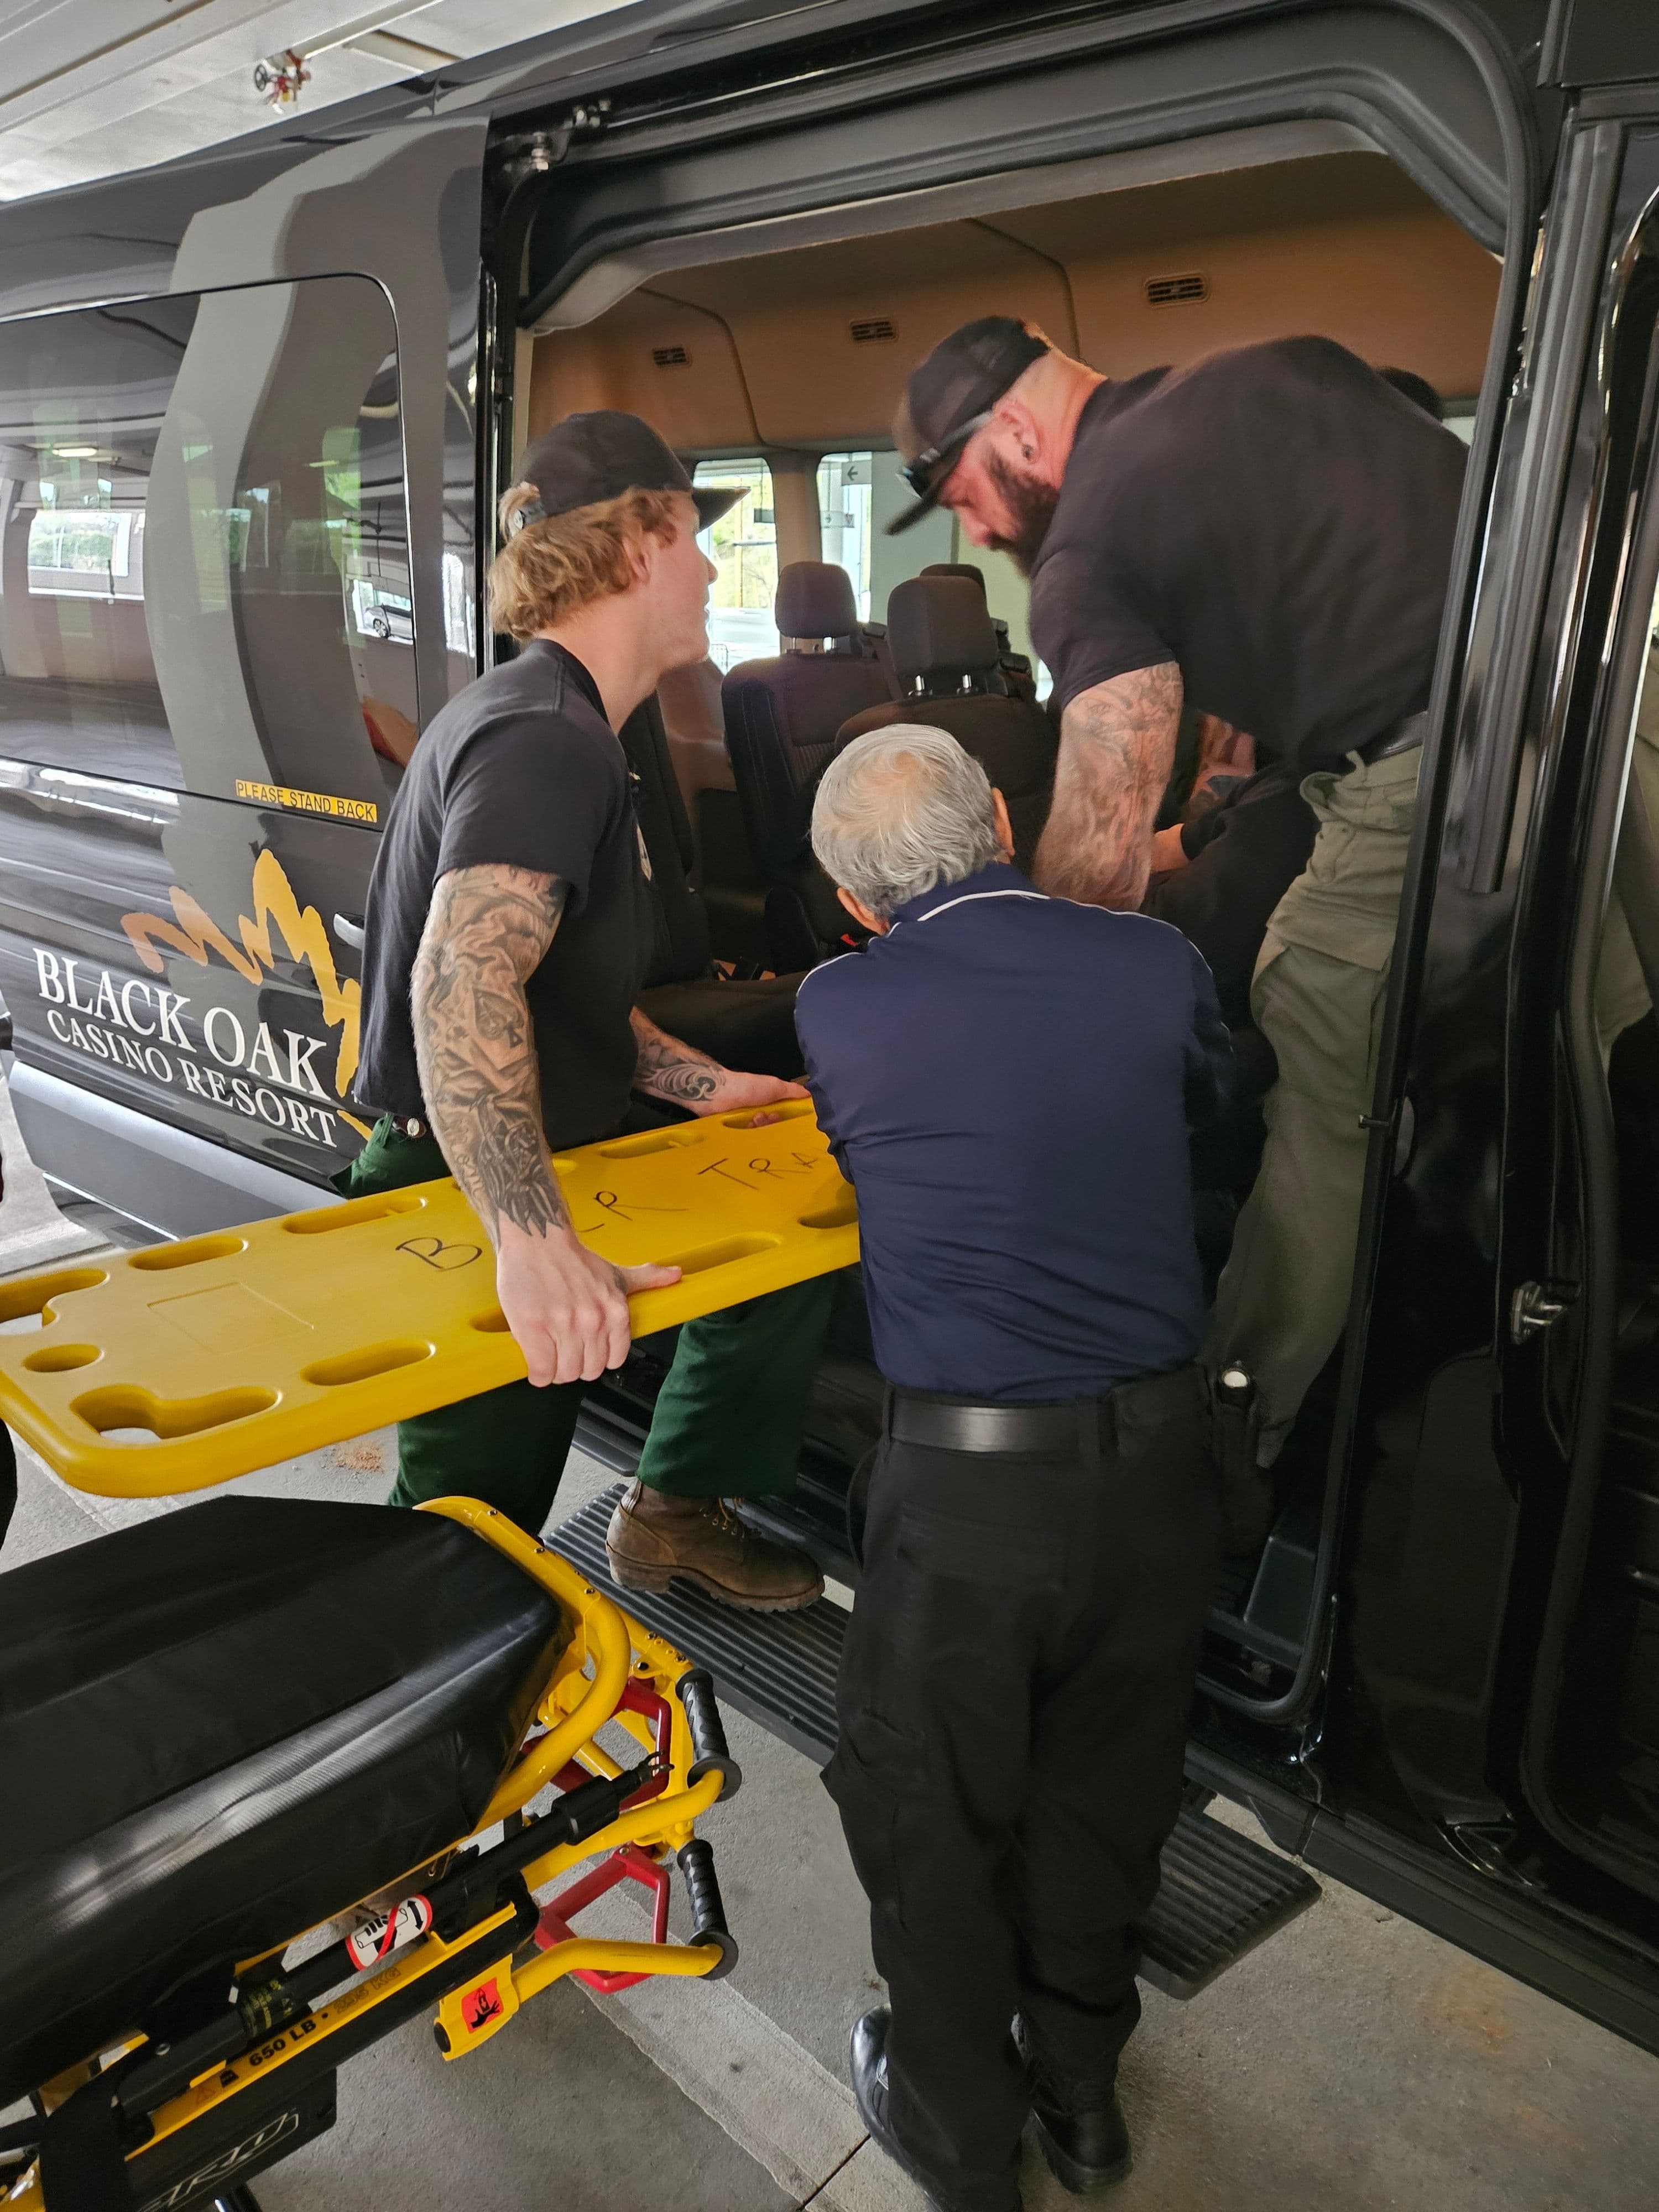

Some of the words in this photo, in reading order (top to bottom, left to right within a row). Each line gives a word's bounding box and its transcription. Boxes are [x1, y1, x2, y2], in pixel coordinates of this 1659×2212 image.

[237, 781, 284, 803] PLEASE
[289, 791, 331, 812] STAND
[337, 800, 375, 822] BACK
[33, 947, 197, 1053] BLACK
[203, 1006, 331, 1102] OAK
[46, 1009, 173, 1083] CASINO
[176, 1057, 337, 1149] RESORT
[249, 2037, 286, 2067] 650
[289, 2019, 317, 2041] LB
